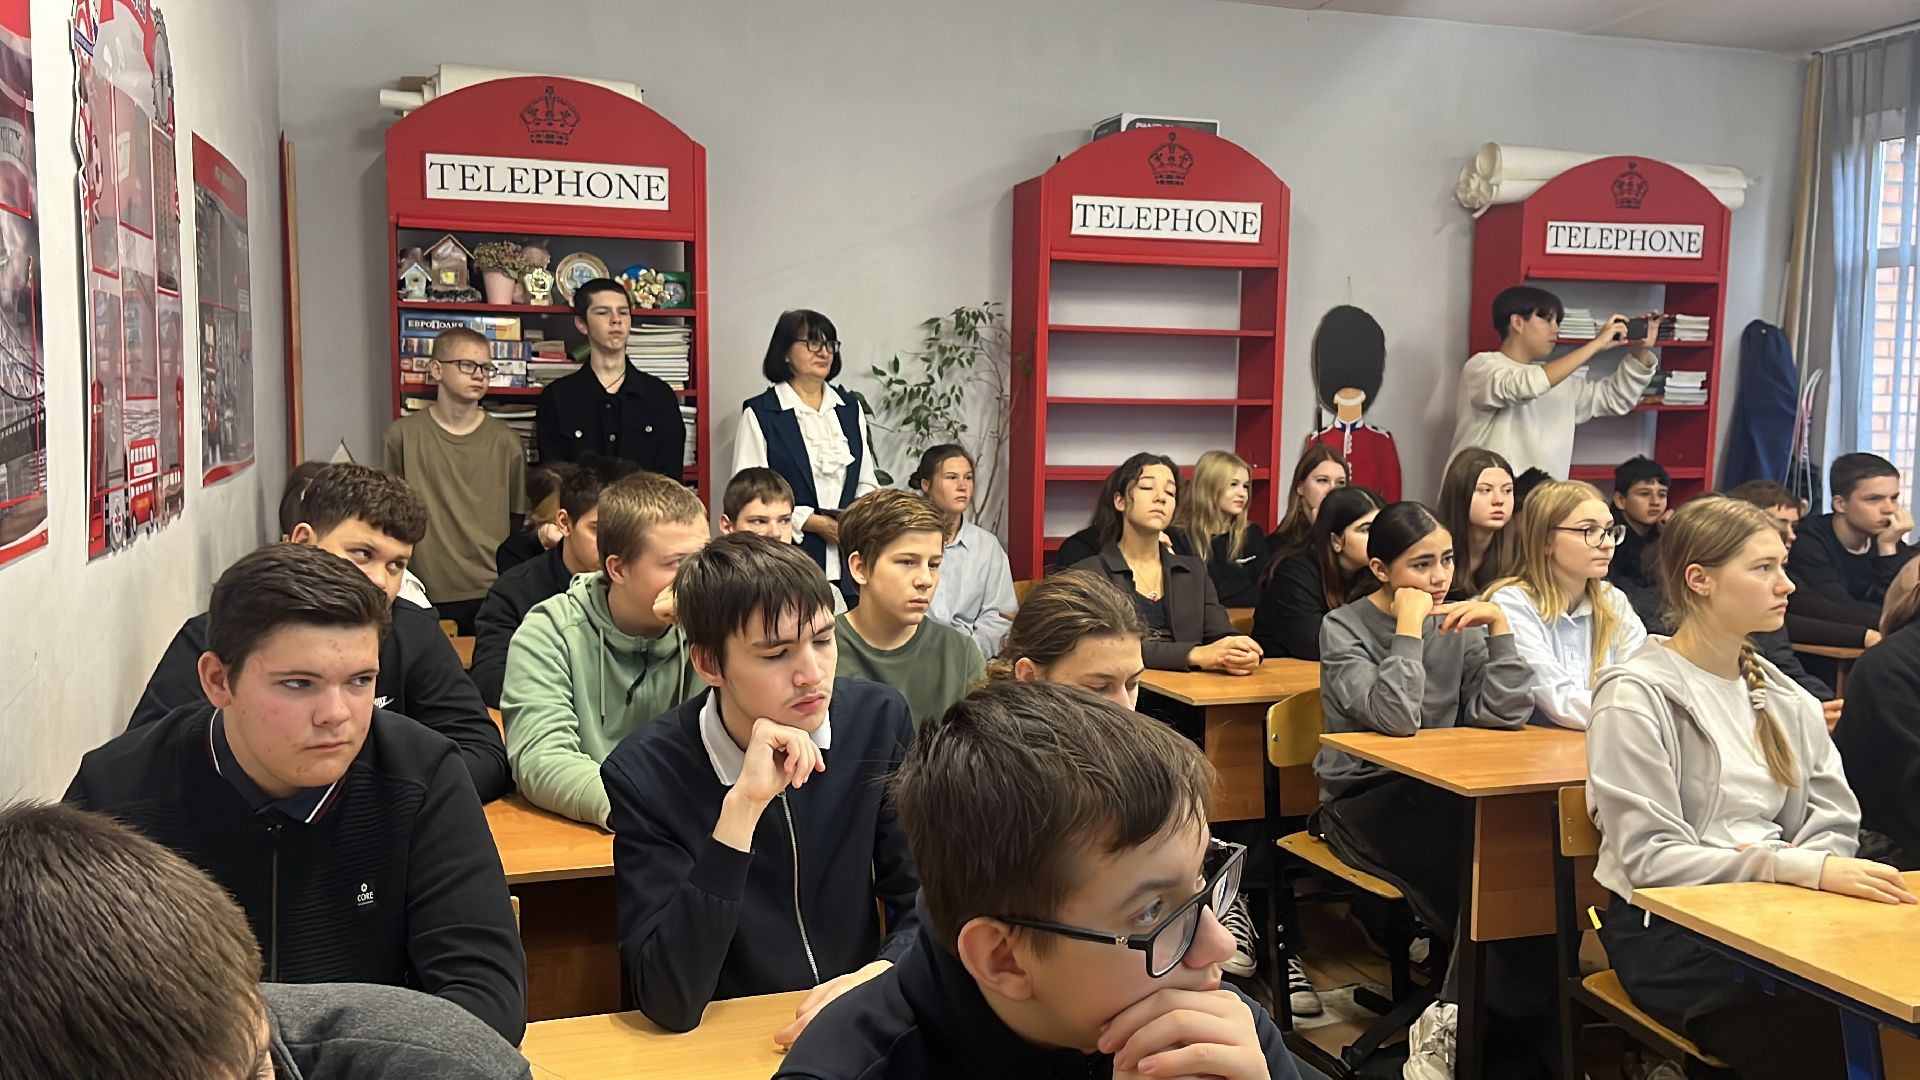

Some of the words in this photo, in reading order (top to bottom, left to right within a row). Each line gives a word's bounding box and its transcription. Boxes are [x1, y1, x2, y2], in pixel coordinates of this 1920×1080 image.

[429, 161, 667, 202] TELEPHONE
[1075, 203, 1258, 235] TELEPHONE
[1549, 224, 1701, 254] TELEPHONE
[357, 891, 374, 902] CORE
